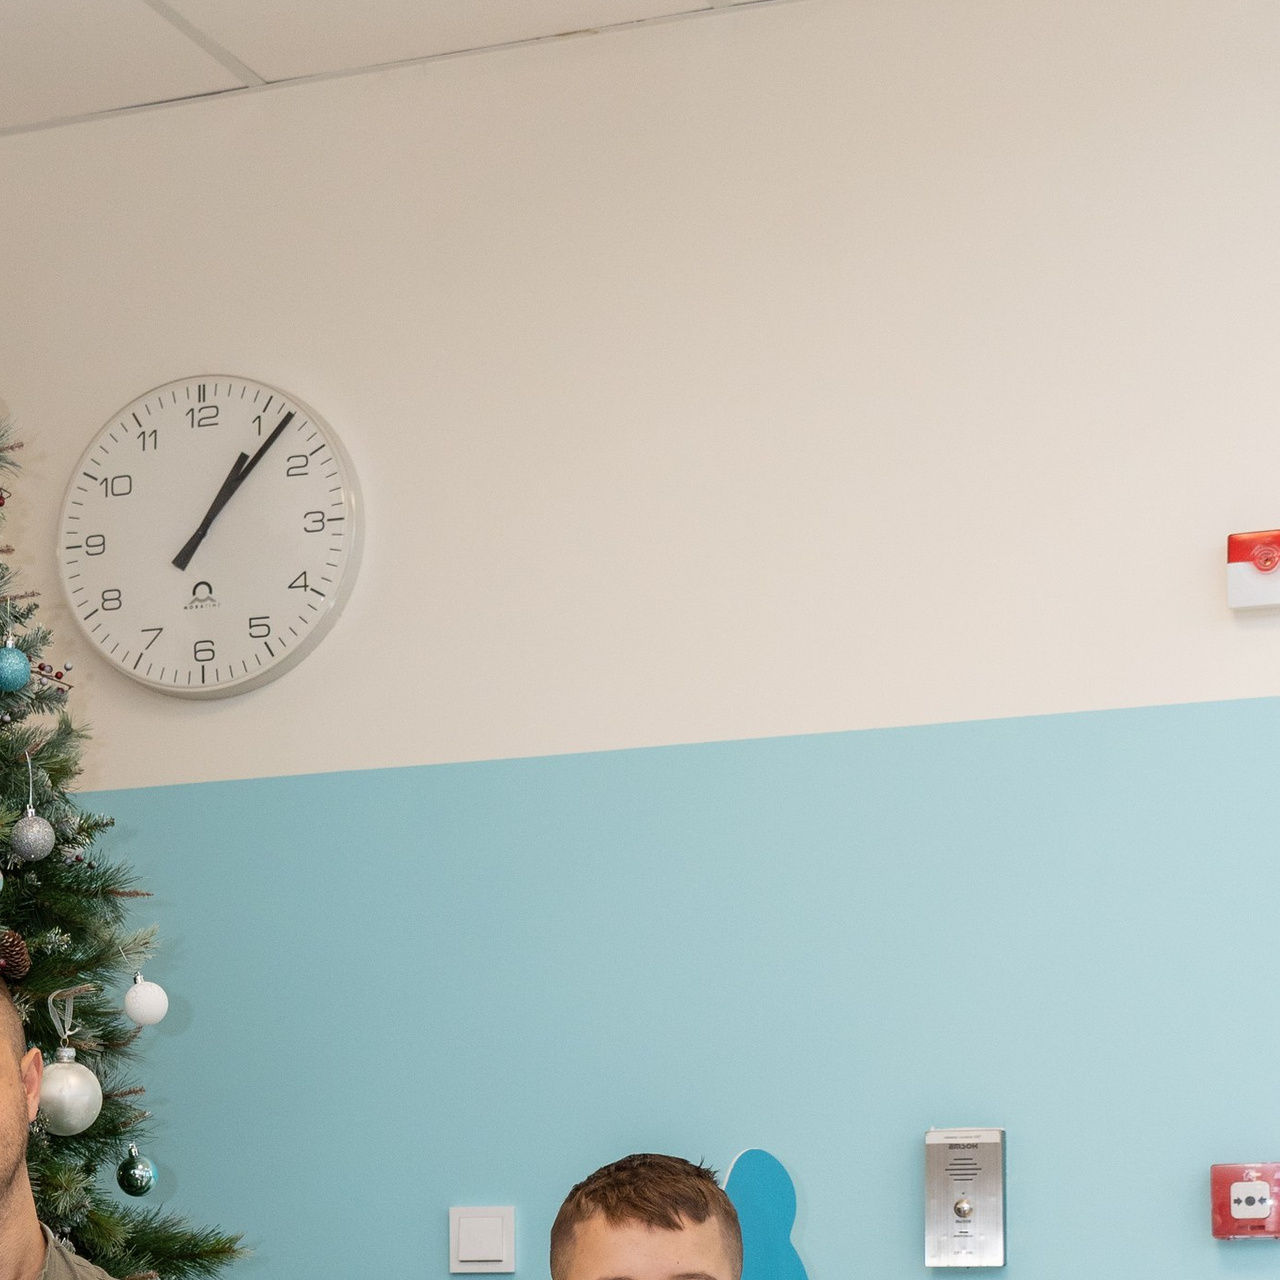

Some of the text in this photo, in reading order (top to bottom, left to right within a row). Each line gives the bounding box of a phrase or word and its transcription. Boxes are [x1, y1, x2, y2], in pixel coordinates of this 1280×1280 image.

[185, 405, 219, 428] 12
[251, 415, 262, 436] 1
[137, 429, 158, 452] 11
[286, 455, 309, 477] 2
[99, 474, 132, 498] 10
[303, 511, 325, 533] 3
[85, 534, 106, 556] 9
[287, 571, 310, 593] 4
[101, 588, 122, 611] 8
[141, 627, 163, 650] 7
[249, 616, 271, 639] 5
[193, 640, 215, 662] 6
